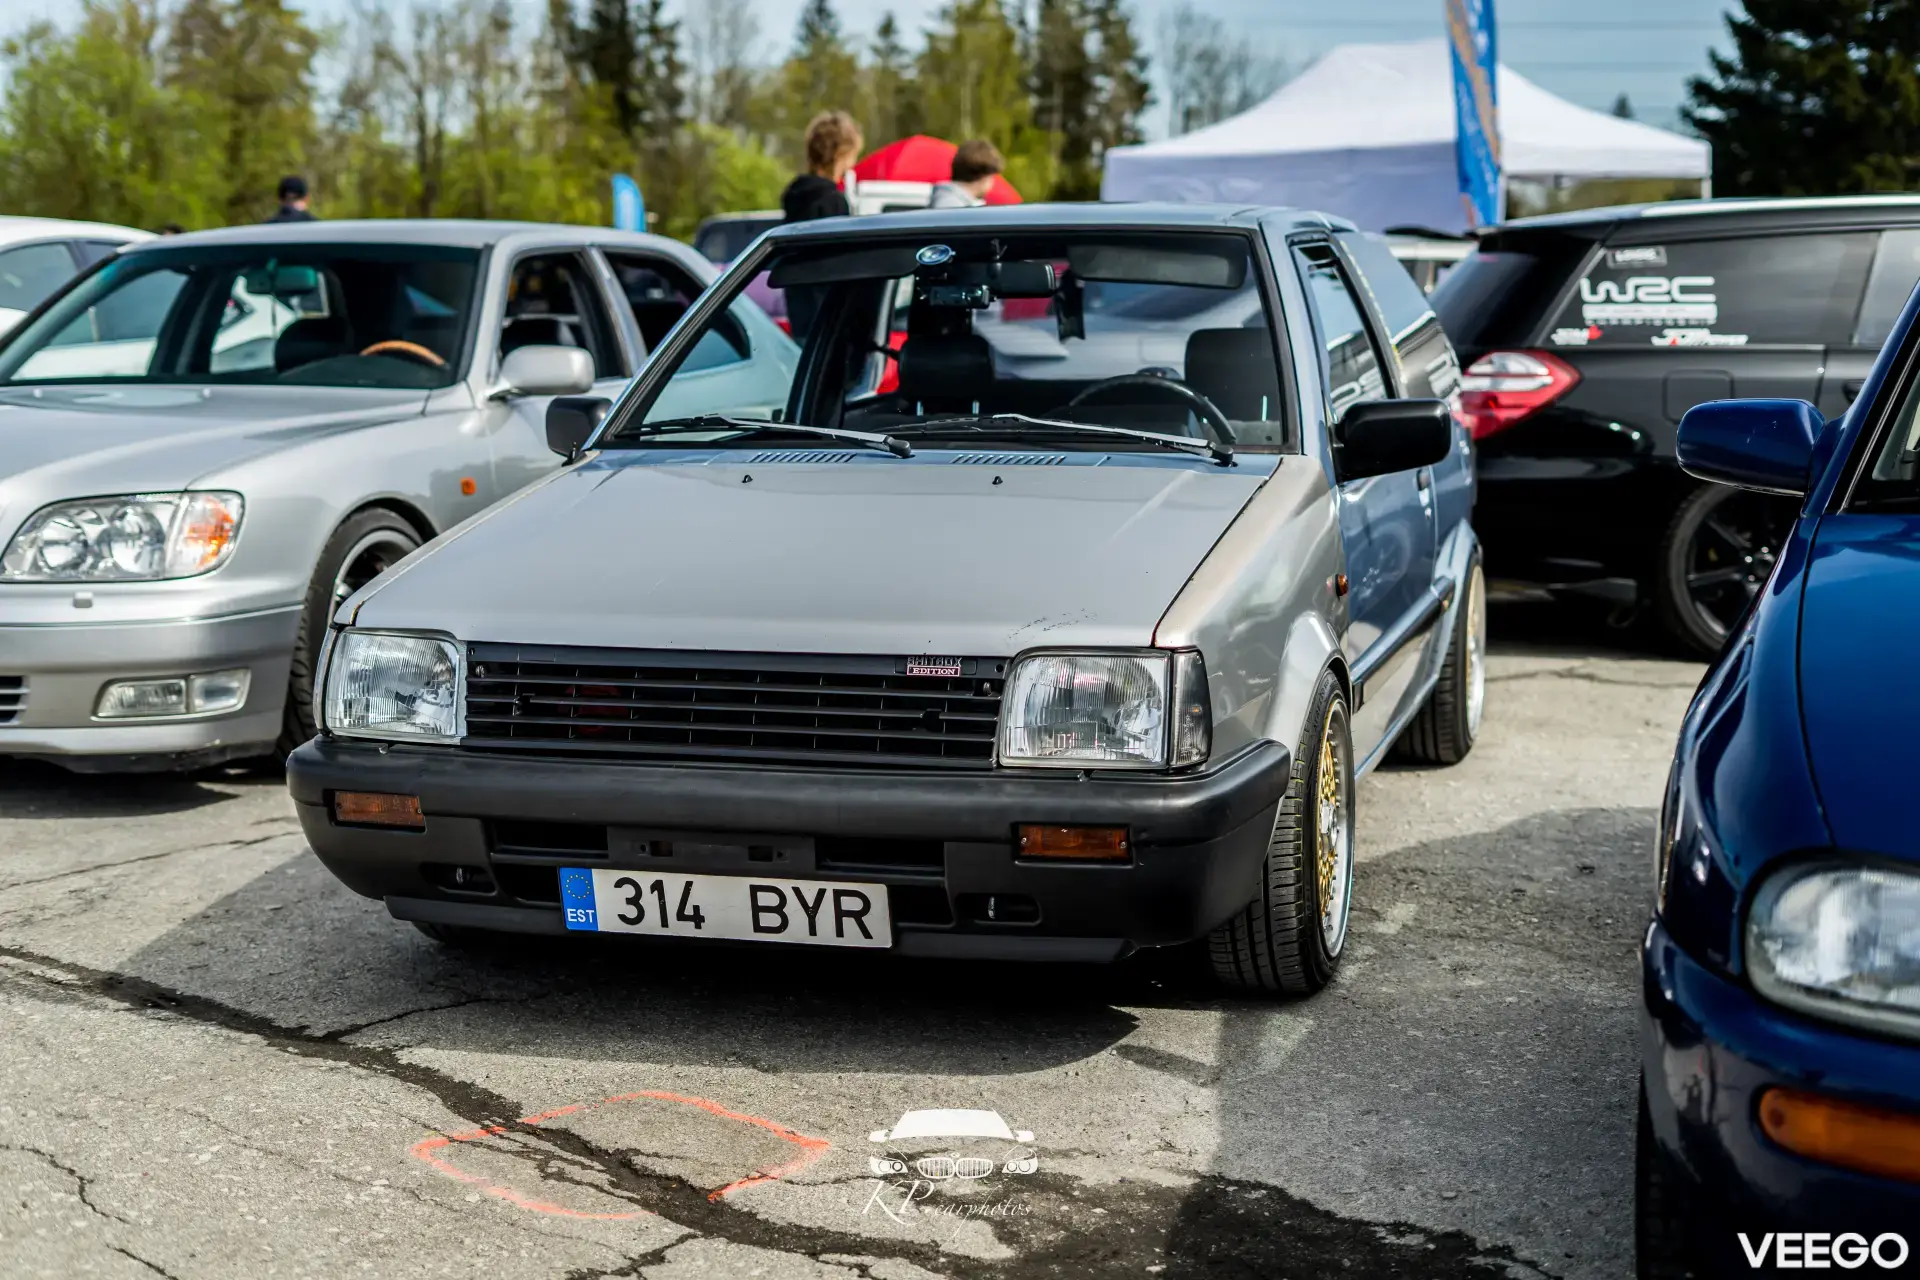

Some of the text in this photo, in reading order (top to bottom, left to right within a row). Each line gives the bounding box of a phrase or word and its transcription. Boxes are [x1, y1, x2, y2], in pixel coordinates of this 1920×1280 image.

[1580, 276, 1717, 303] WRC
[912, 667, 956, 675] EDITION
[567, 908, 595, 924] EST
[613, 877, 874, 940] 314 BYR
